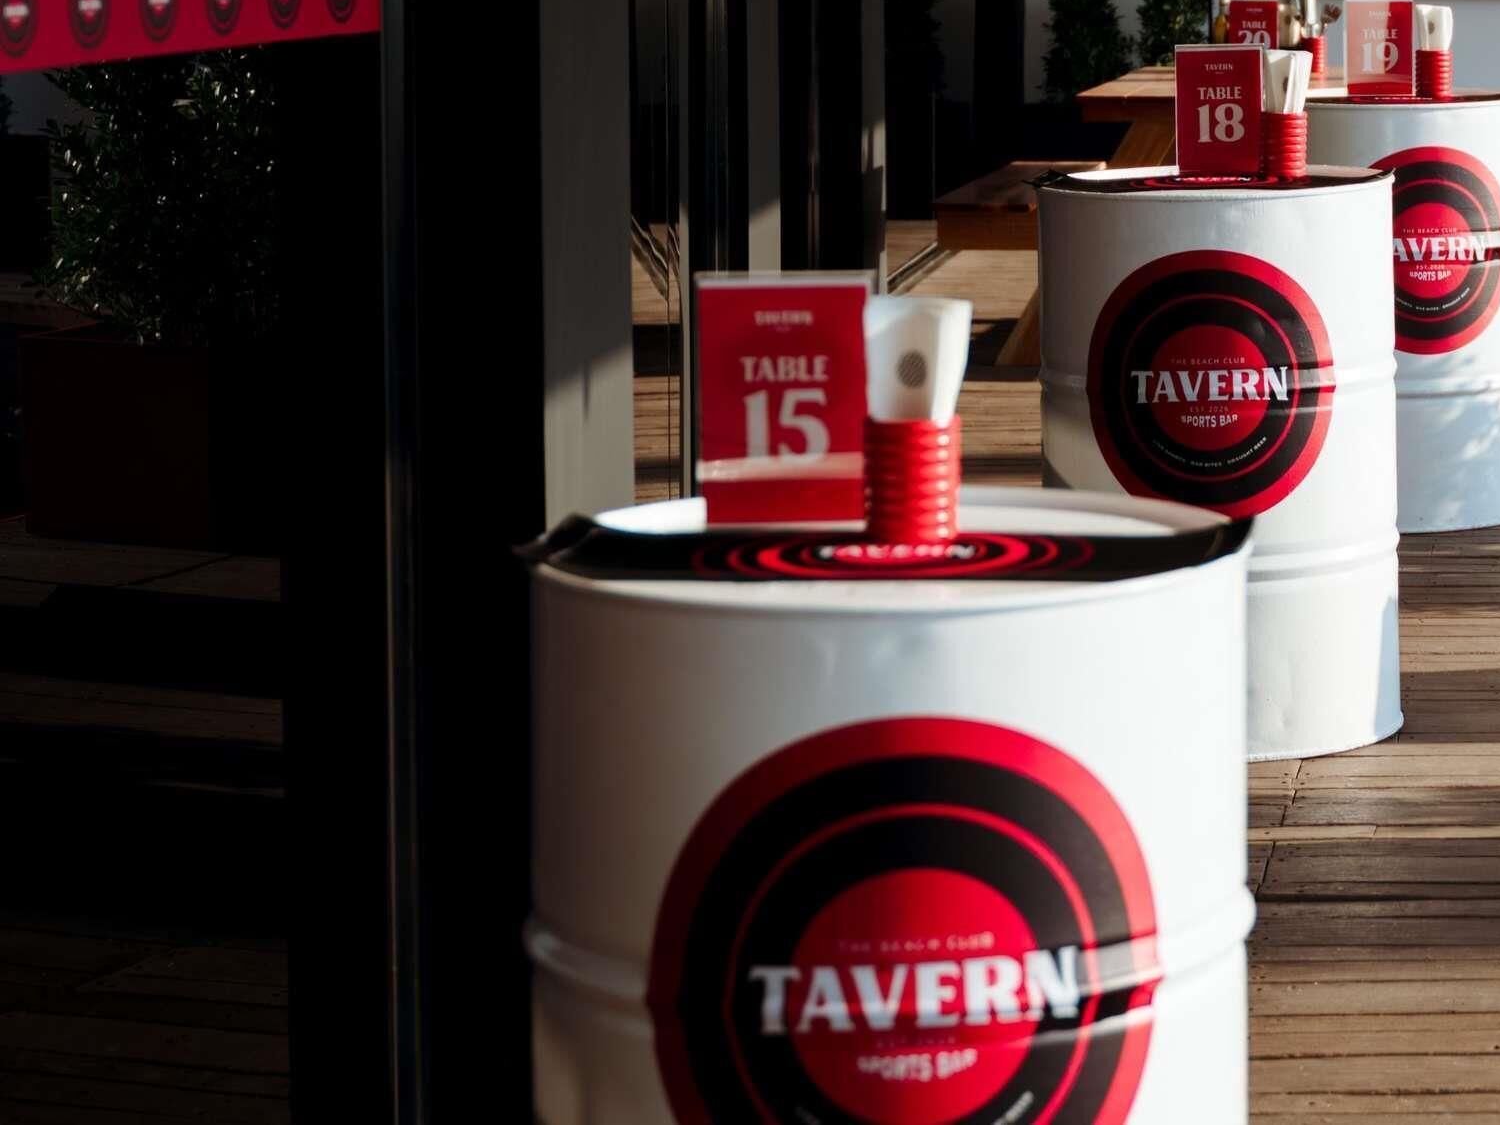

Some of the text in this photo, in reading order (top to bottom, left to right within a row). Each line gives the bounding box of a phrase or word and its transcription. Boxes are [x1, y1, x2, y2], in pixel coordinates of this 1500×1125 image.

[1241, 20, 1267, 29] TABLE
[1362, 28, 1398, 39] TABLE
[1204, 63, 1234, 71] TAVERN
[1361, 41, 1399, 73] 19
[1196, 86, 1243, 100] TABLE
[1197, 103, 1246, 144] 18
[1393, 235, 1486, 263] AVERN
[740, 354, 830, 383] TABLE
[1190, 357, 1220, 365] BEACH
[1223, 356, 1246, 365] CLUB
[1130, 365, 1289, 405] TAVERN
[743, 387, 831, 464] 15
[1180, 413, 1239, 428] SPORTS BAR
[749, 945, 1081, 1036] TAVERN
